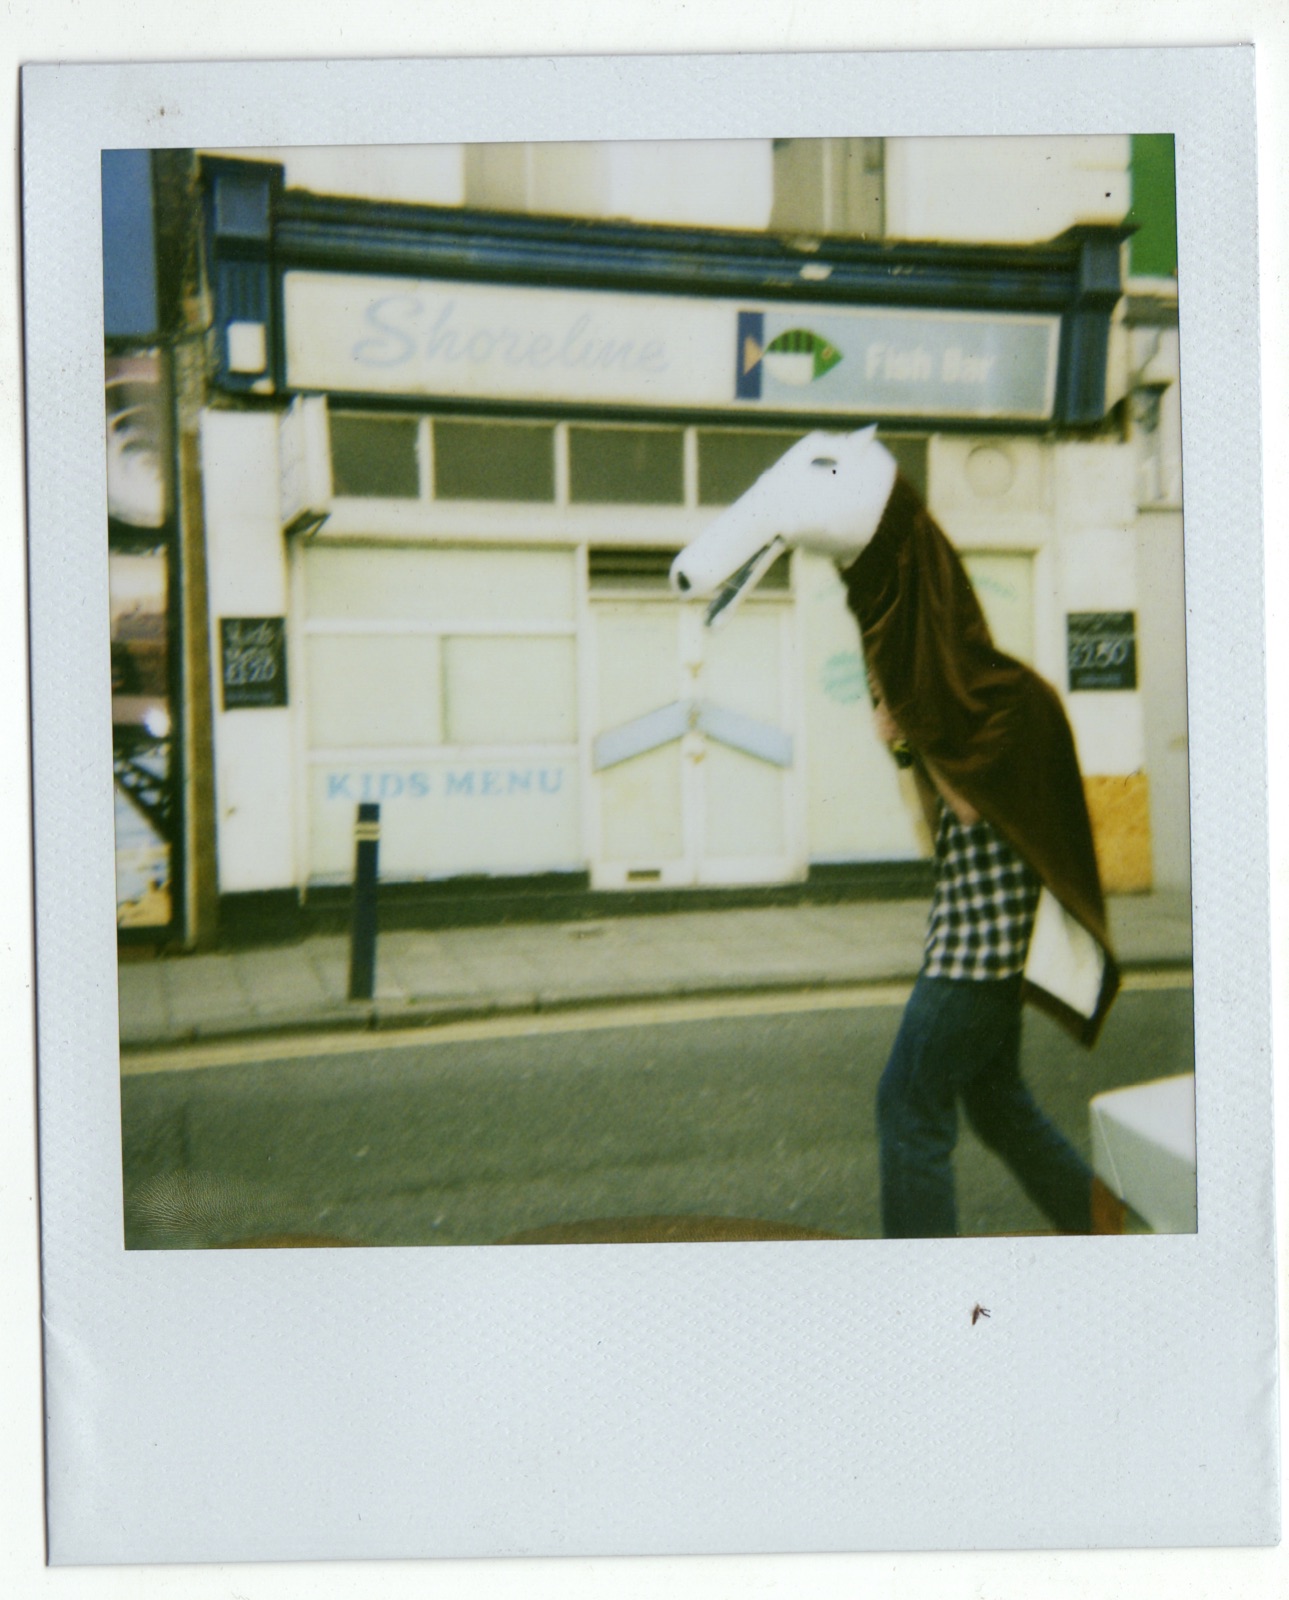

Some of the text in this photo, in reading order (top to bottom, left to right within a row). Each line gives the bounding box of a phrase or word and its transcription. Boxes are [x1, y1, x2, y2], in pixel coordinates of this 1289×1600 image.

[351, 294, 668, 373] Shoreline
[865, 340, 996, 384] Fish Bar
[326, 768, 563, 798] KIDS MENU
